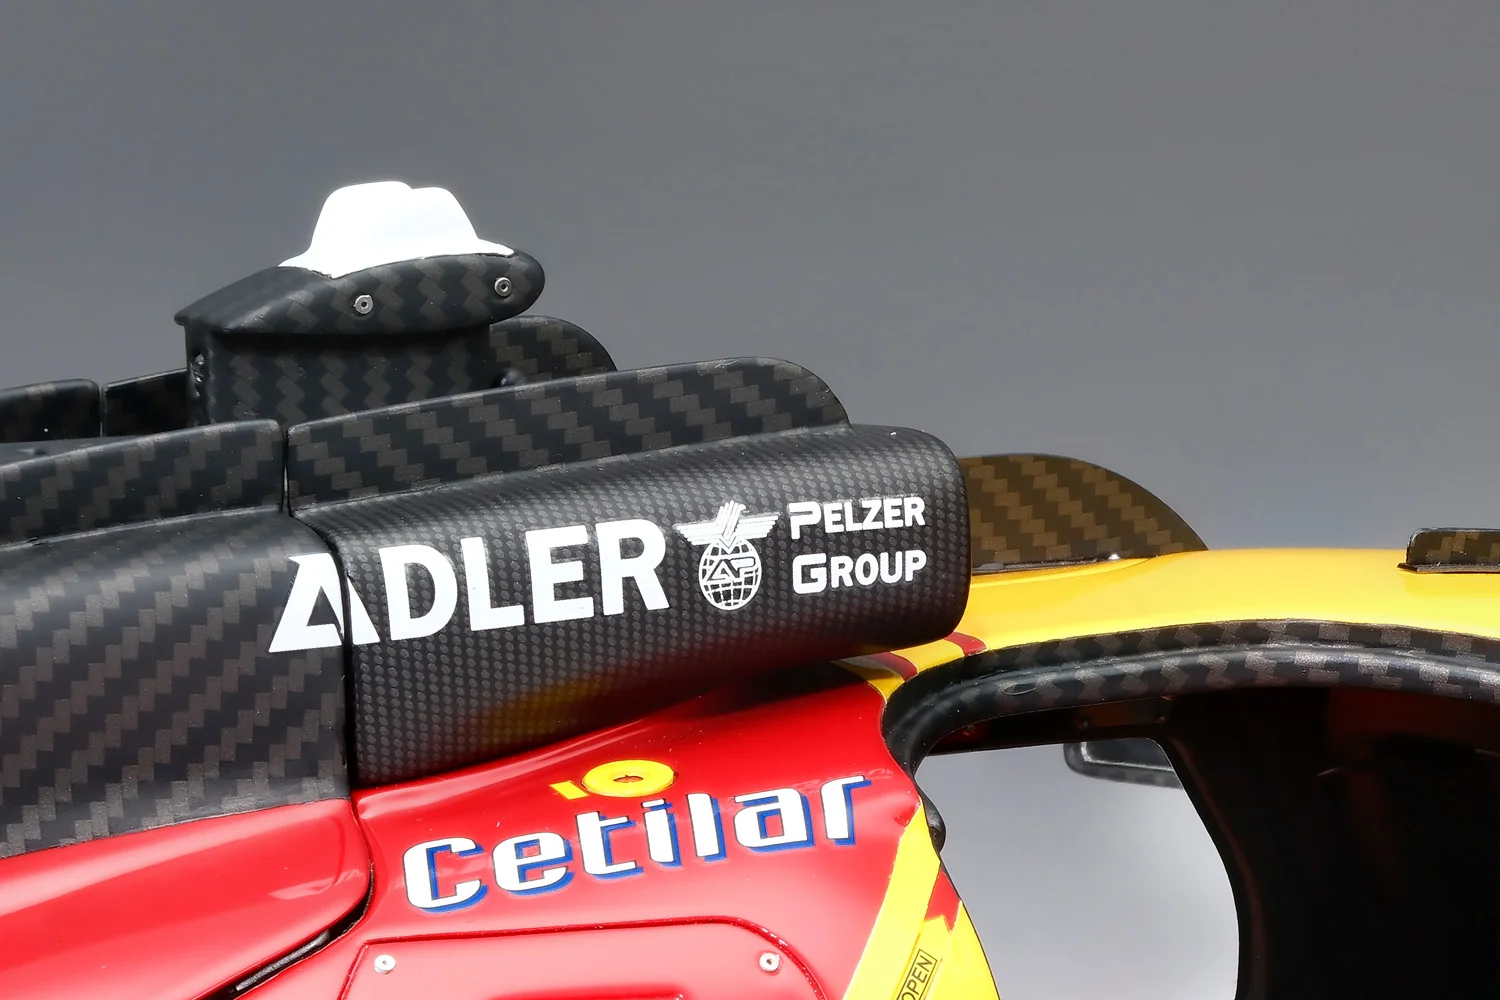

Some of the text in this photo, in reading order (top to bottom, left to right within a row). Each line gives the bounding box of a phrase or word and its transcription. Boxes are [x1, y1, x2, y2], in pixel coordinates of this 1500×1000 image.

[788, 496, 926, 540] PELZER
[268, 518, 671, 653] ADLER
[792, 549, 927, 594] GROUP
